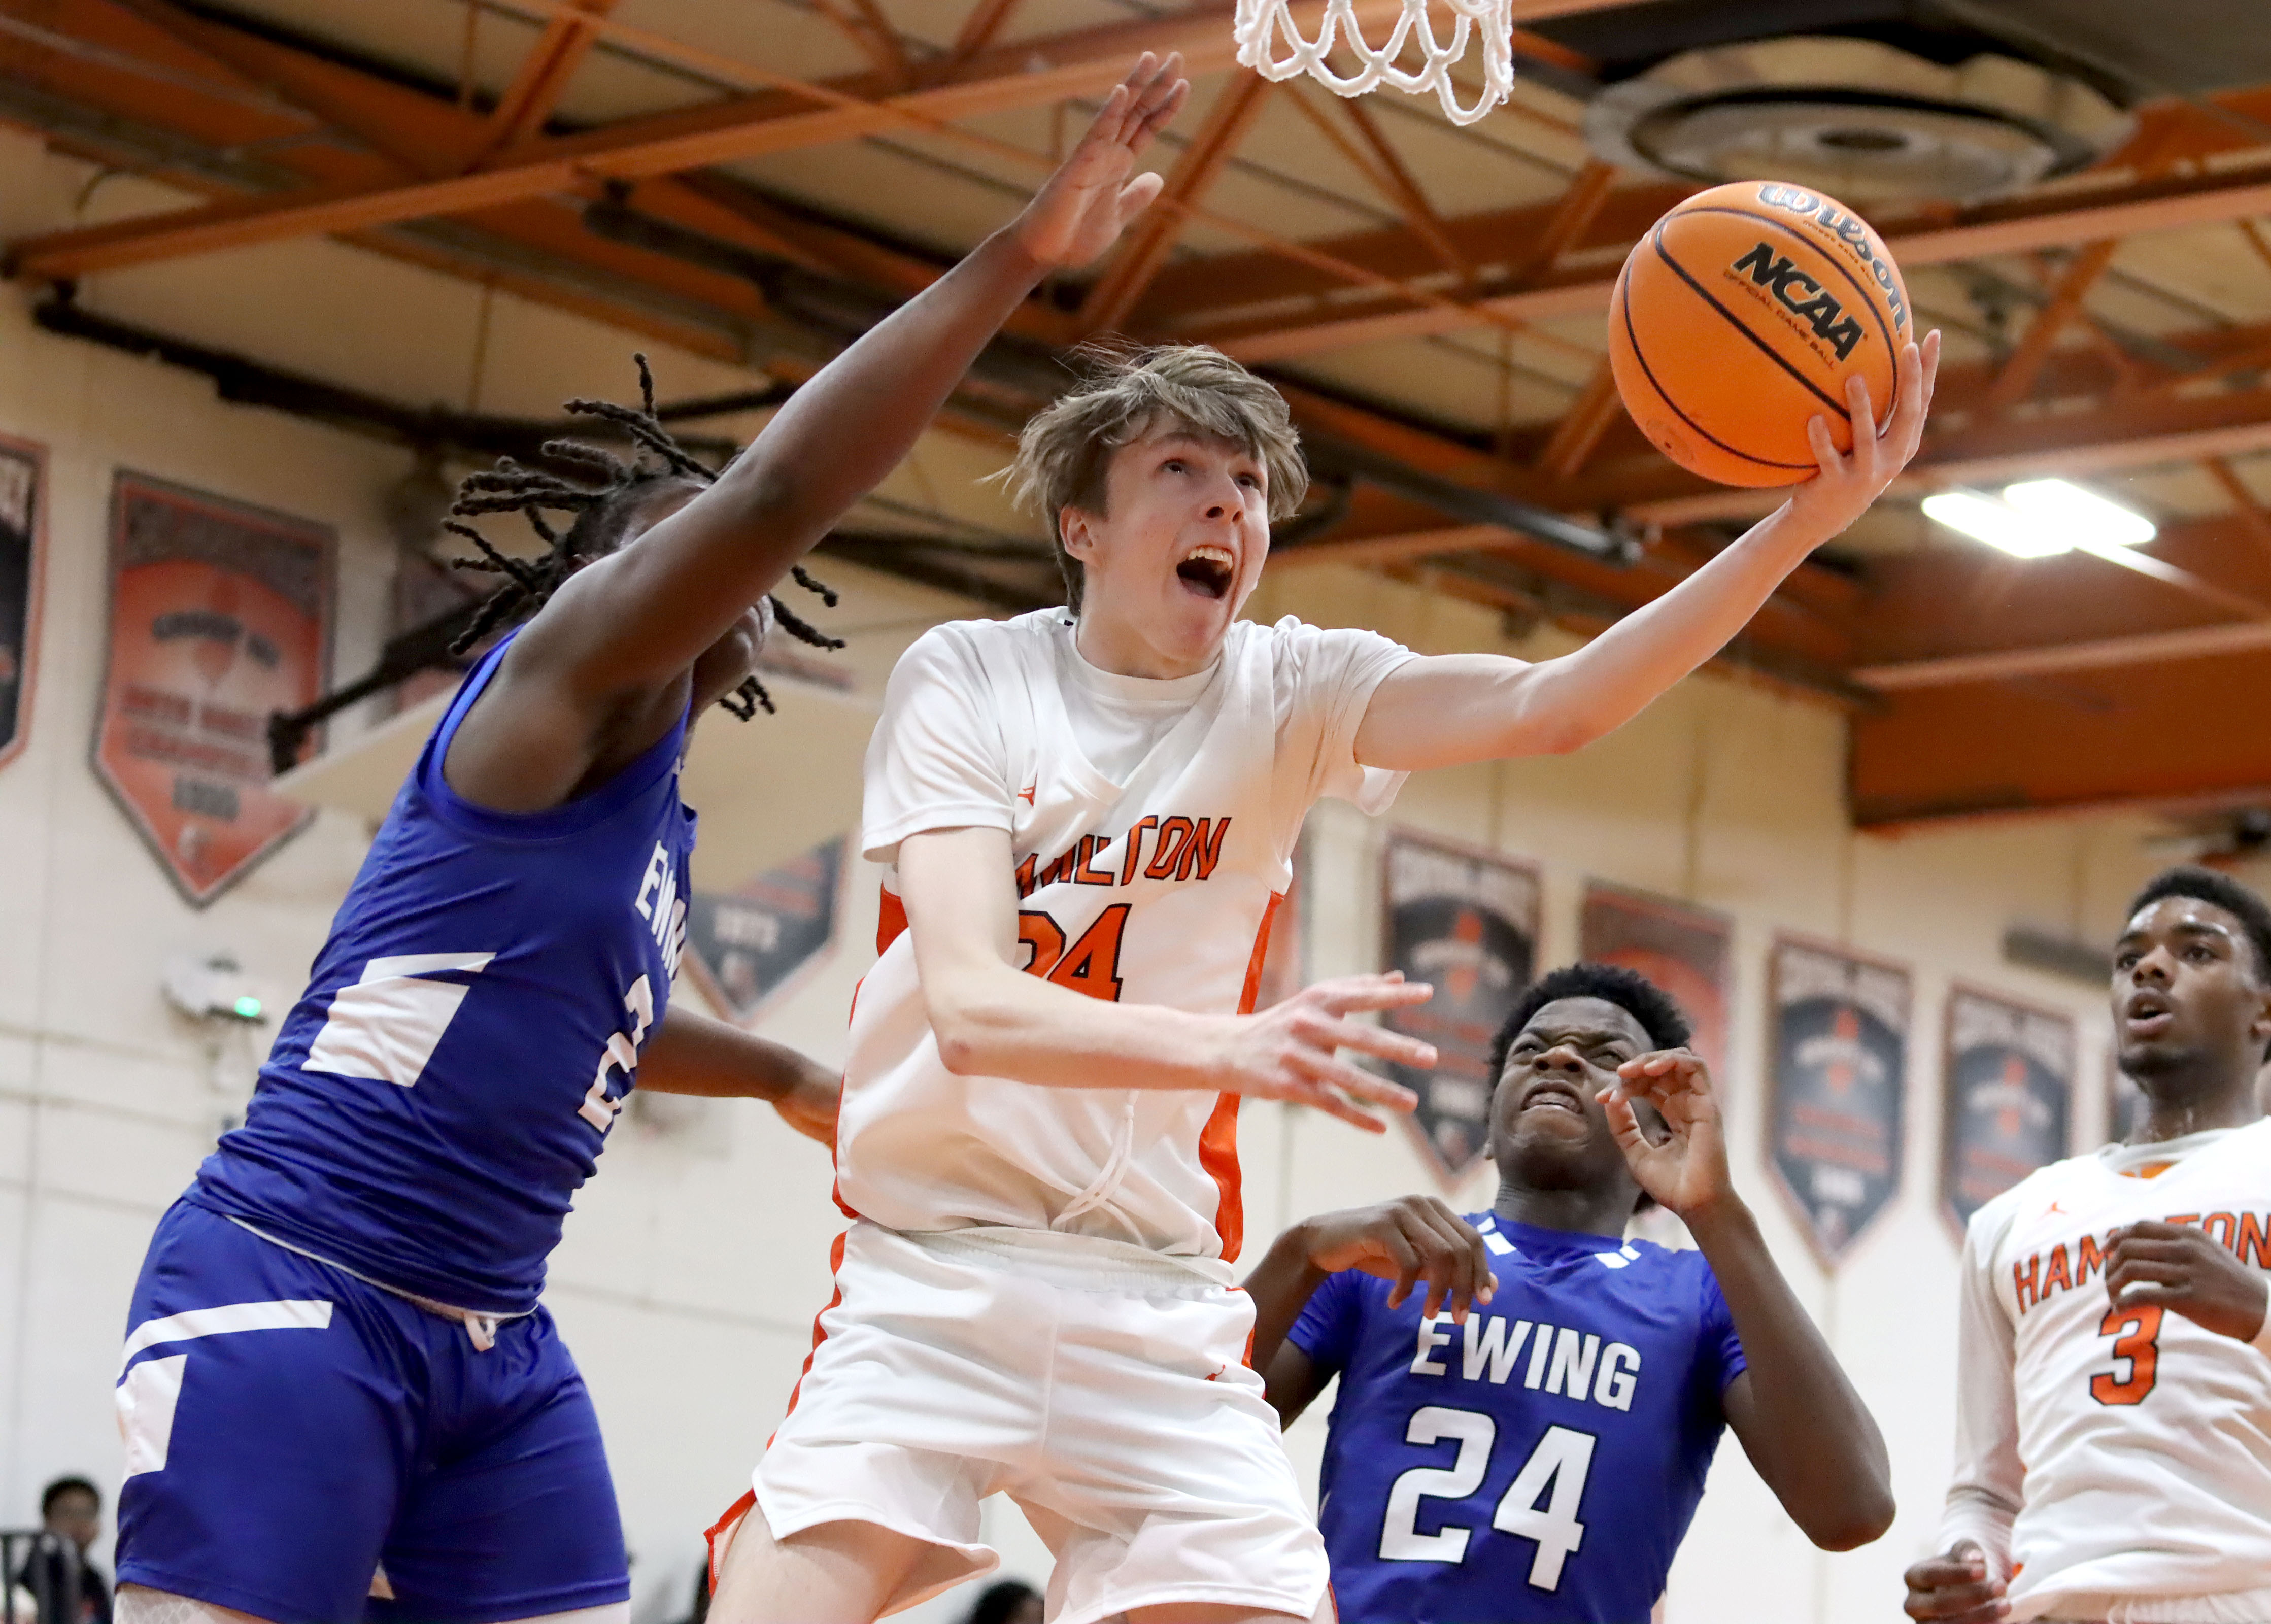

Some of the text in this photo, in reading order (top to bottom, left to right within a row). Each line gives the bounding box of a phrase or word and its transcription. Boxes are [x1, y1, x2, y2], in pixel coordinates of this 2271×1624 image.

[1731, 241, 1864, 362] NCAA
[1757, 184, 1906, 332] Wilson
[1409, 1310, 1642, 1412] EWING
[2089, 1304, 2165, 1405] 3
[1378, 1405, 1597, 1593] 24
